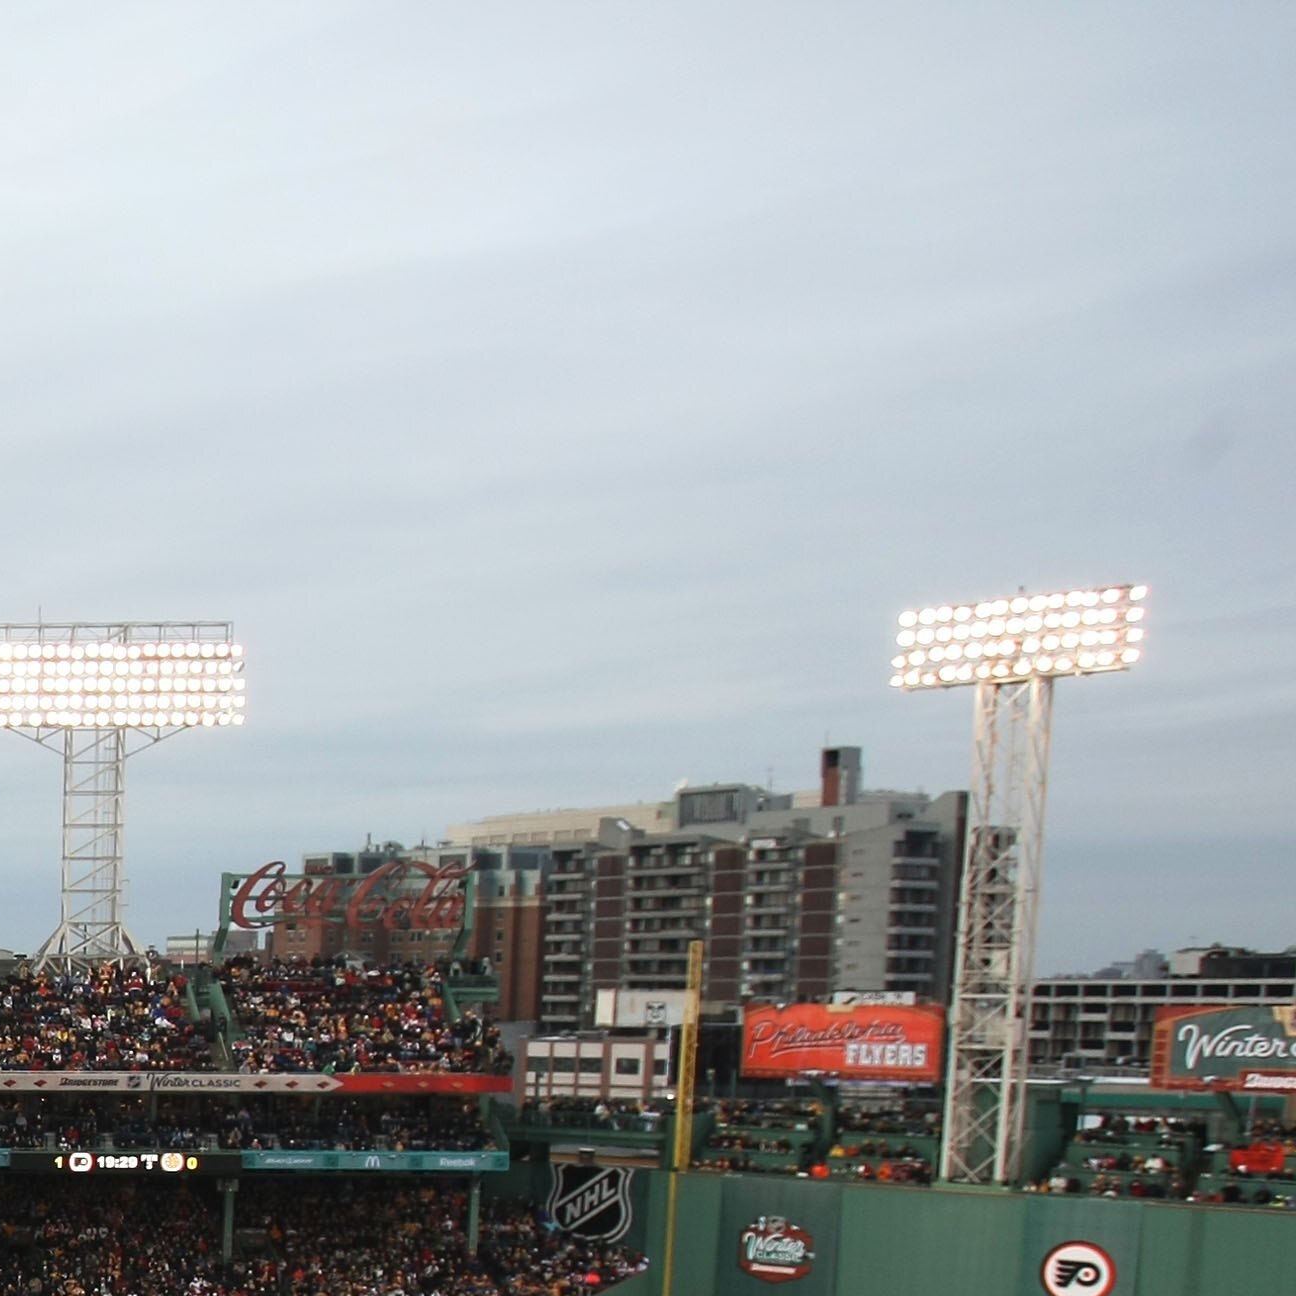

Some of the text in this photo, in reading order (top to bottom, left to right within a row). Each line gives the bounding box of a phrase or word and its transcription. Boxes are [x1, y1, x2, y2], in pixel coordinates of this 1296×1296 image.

[845, 1043, 926, 1067] FLYERS
[1178, 1024, 1289, 1070] Winter
[188, 1079, 241, 1088] CLASSIC
[54, 1156, 64, 1169] 1
[566, 1178, 616, 1225] NHL
